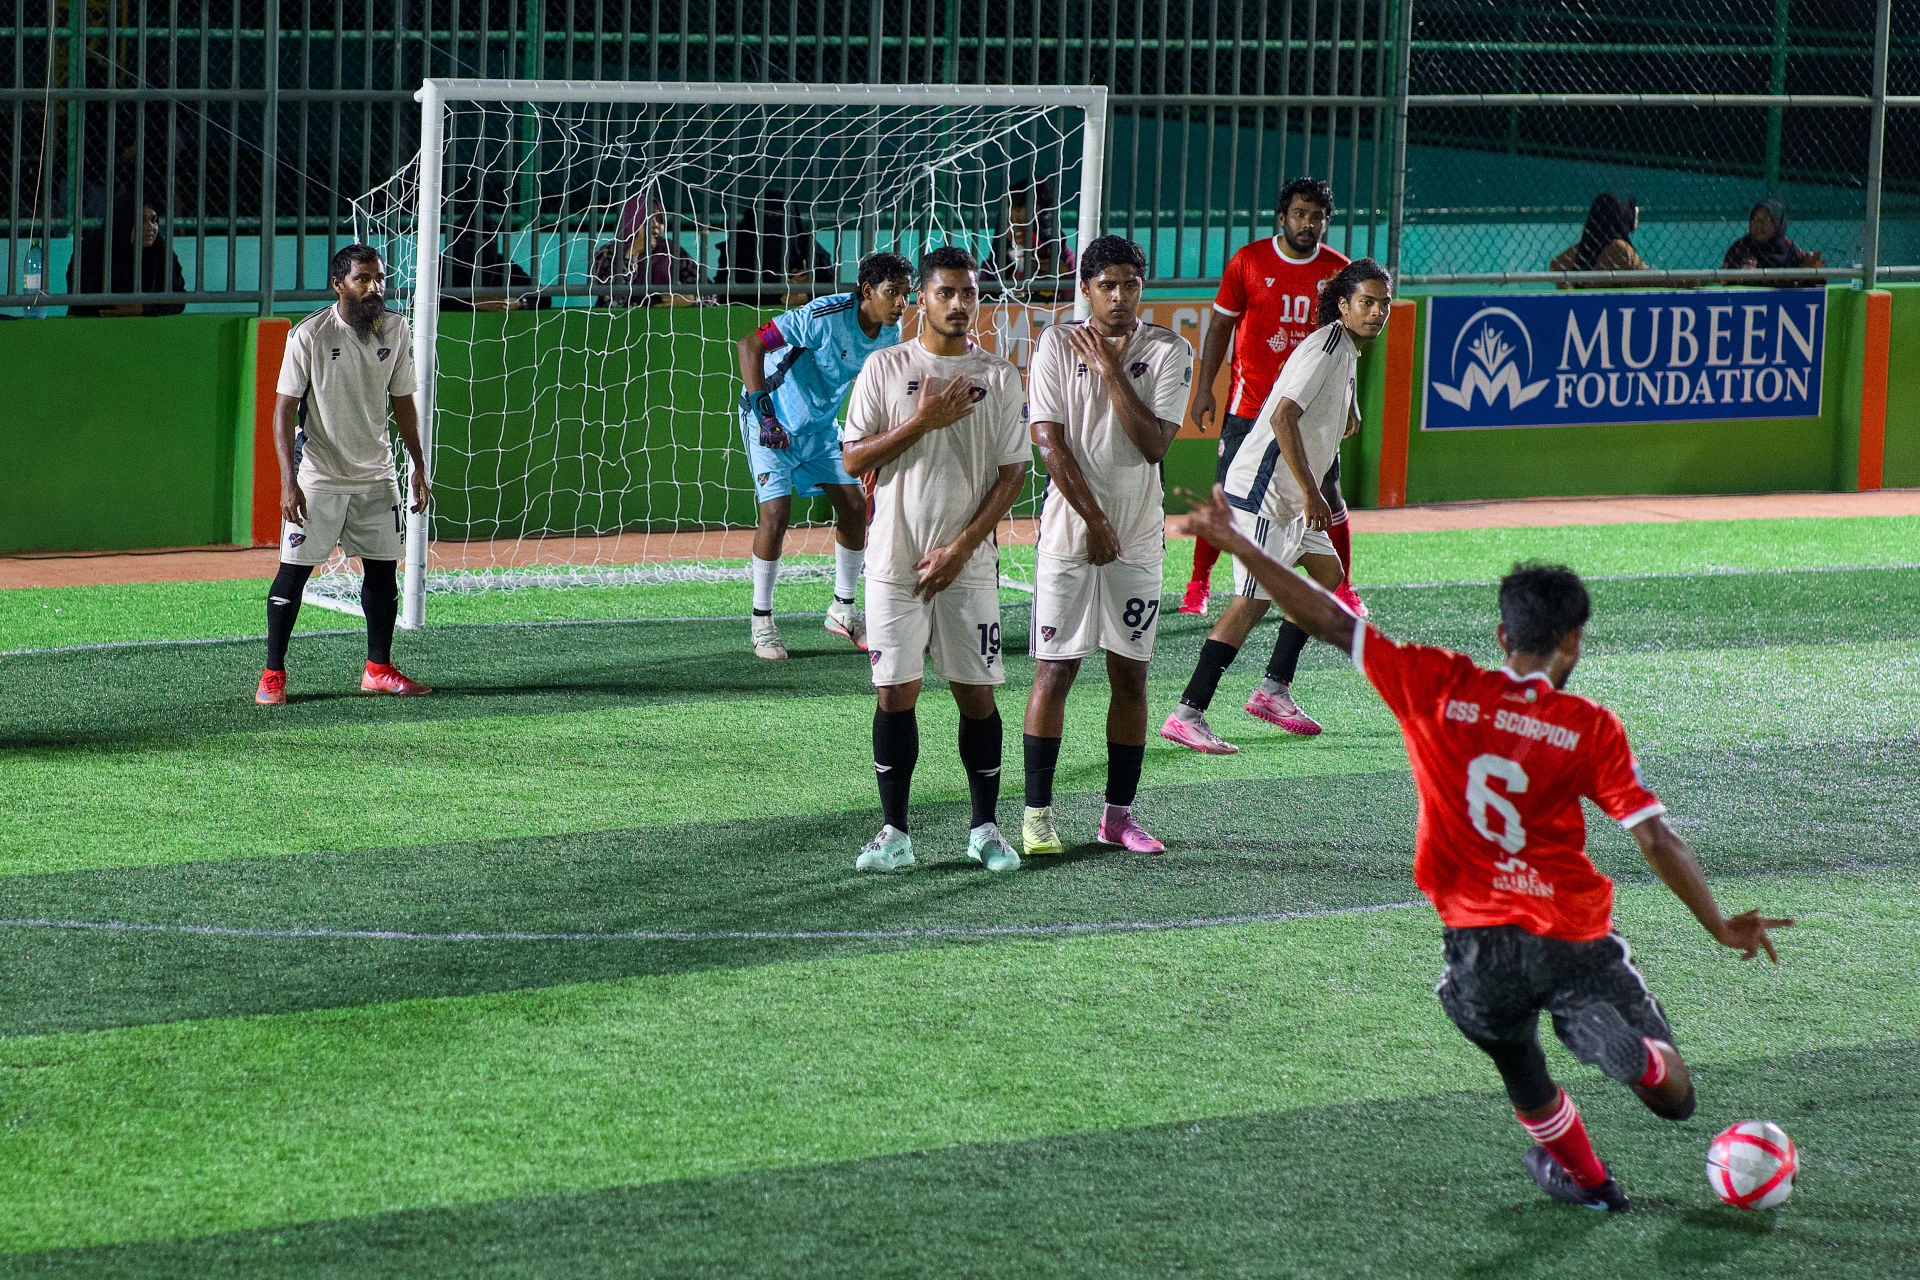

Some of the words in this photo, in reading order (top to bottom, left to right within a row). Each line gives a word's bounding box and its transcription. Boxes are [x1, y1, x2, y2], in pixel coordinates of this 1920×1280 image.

[1279, 294, 1311, 324] 10
[1556, 303, 1820, 371] MUBEEN
[1554, 367, 1812, 409] FOUNDATION
[1122, 597, 1160, 631] 87
[977, 622, 1001, 655] 19
[1493, 708, 1581, 751] SCORPION
[1466, 753, 1530, 854] 6
